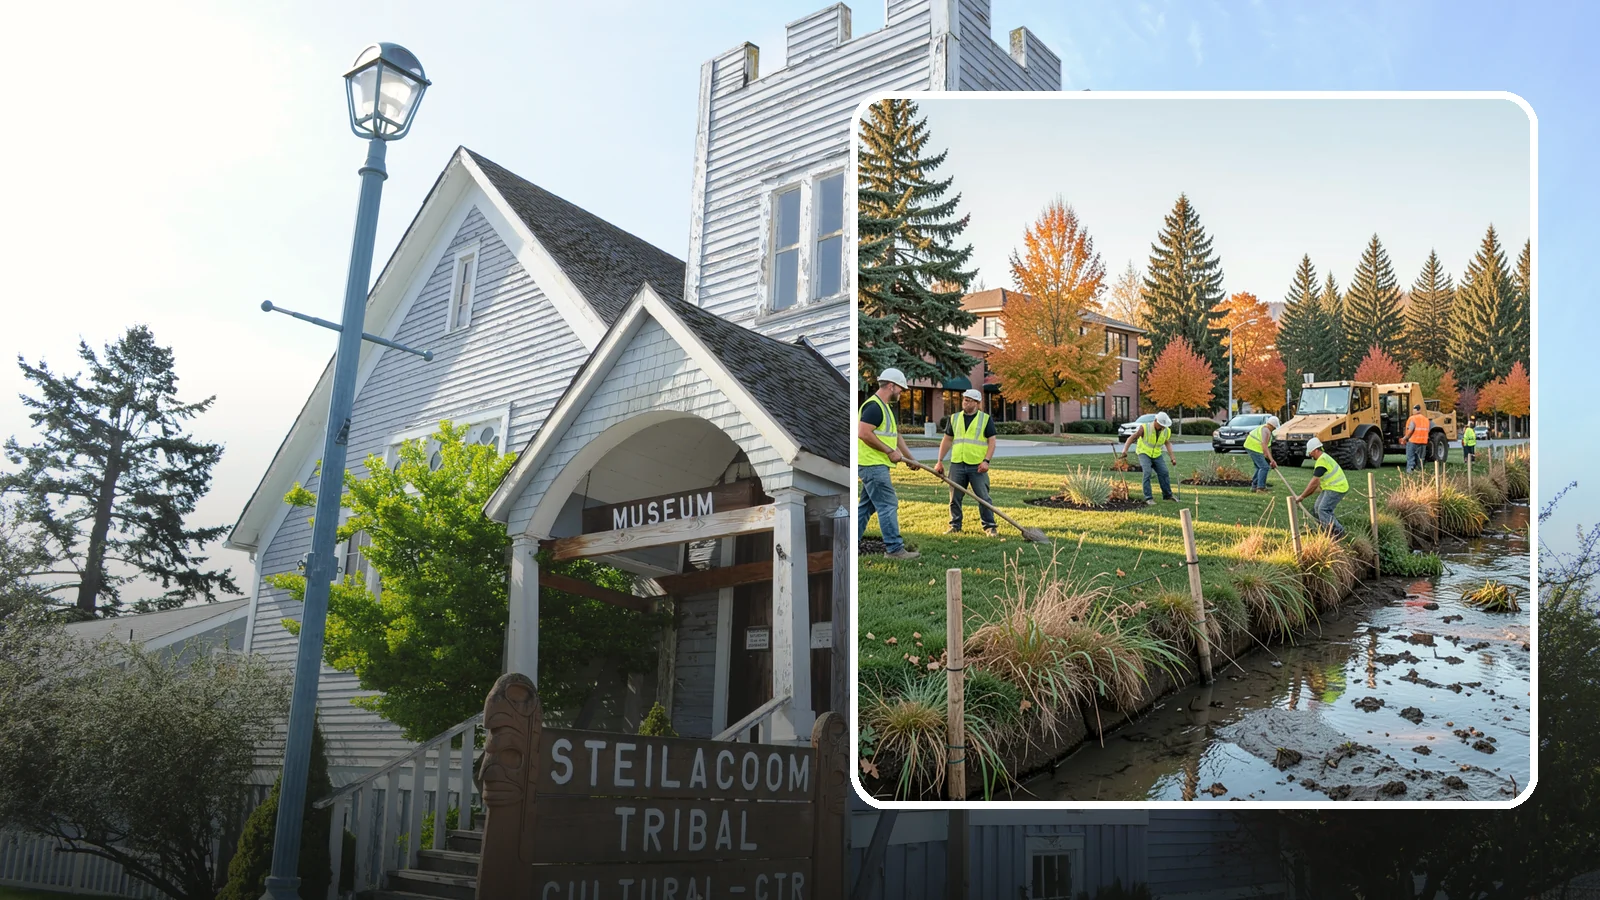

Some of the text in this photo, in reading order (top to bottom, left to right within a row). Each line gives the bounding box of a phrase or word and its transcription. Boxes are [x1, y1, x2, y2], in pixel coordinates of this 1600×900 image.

[613, 491, 713, 530] MUSEUM
[551, 738, 809, 792] STEILACOOM
[615, 807, 757, 852] TRIBAL
